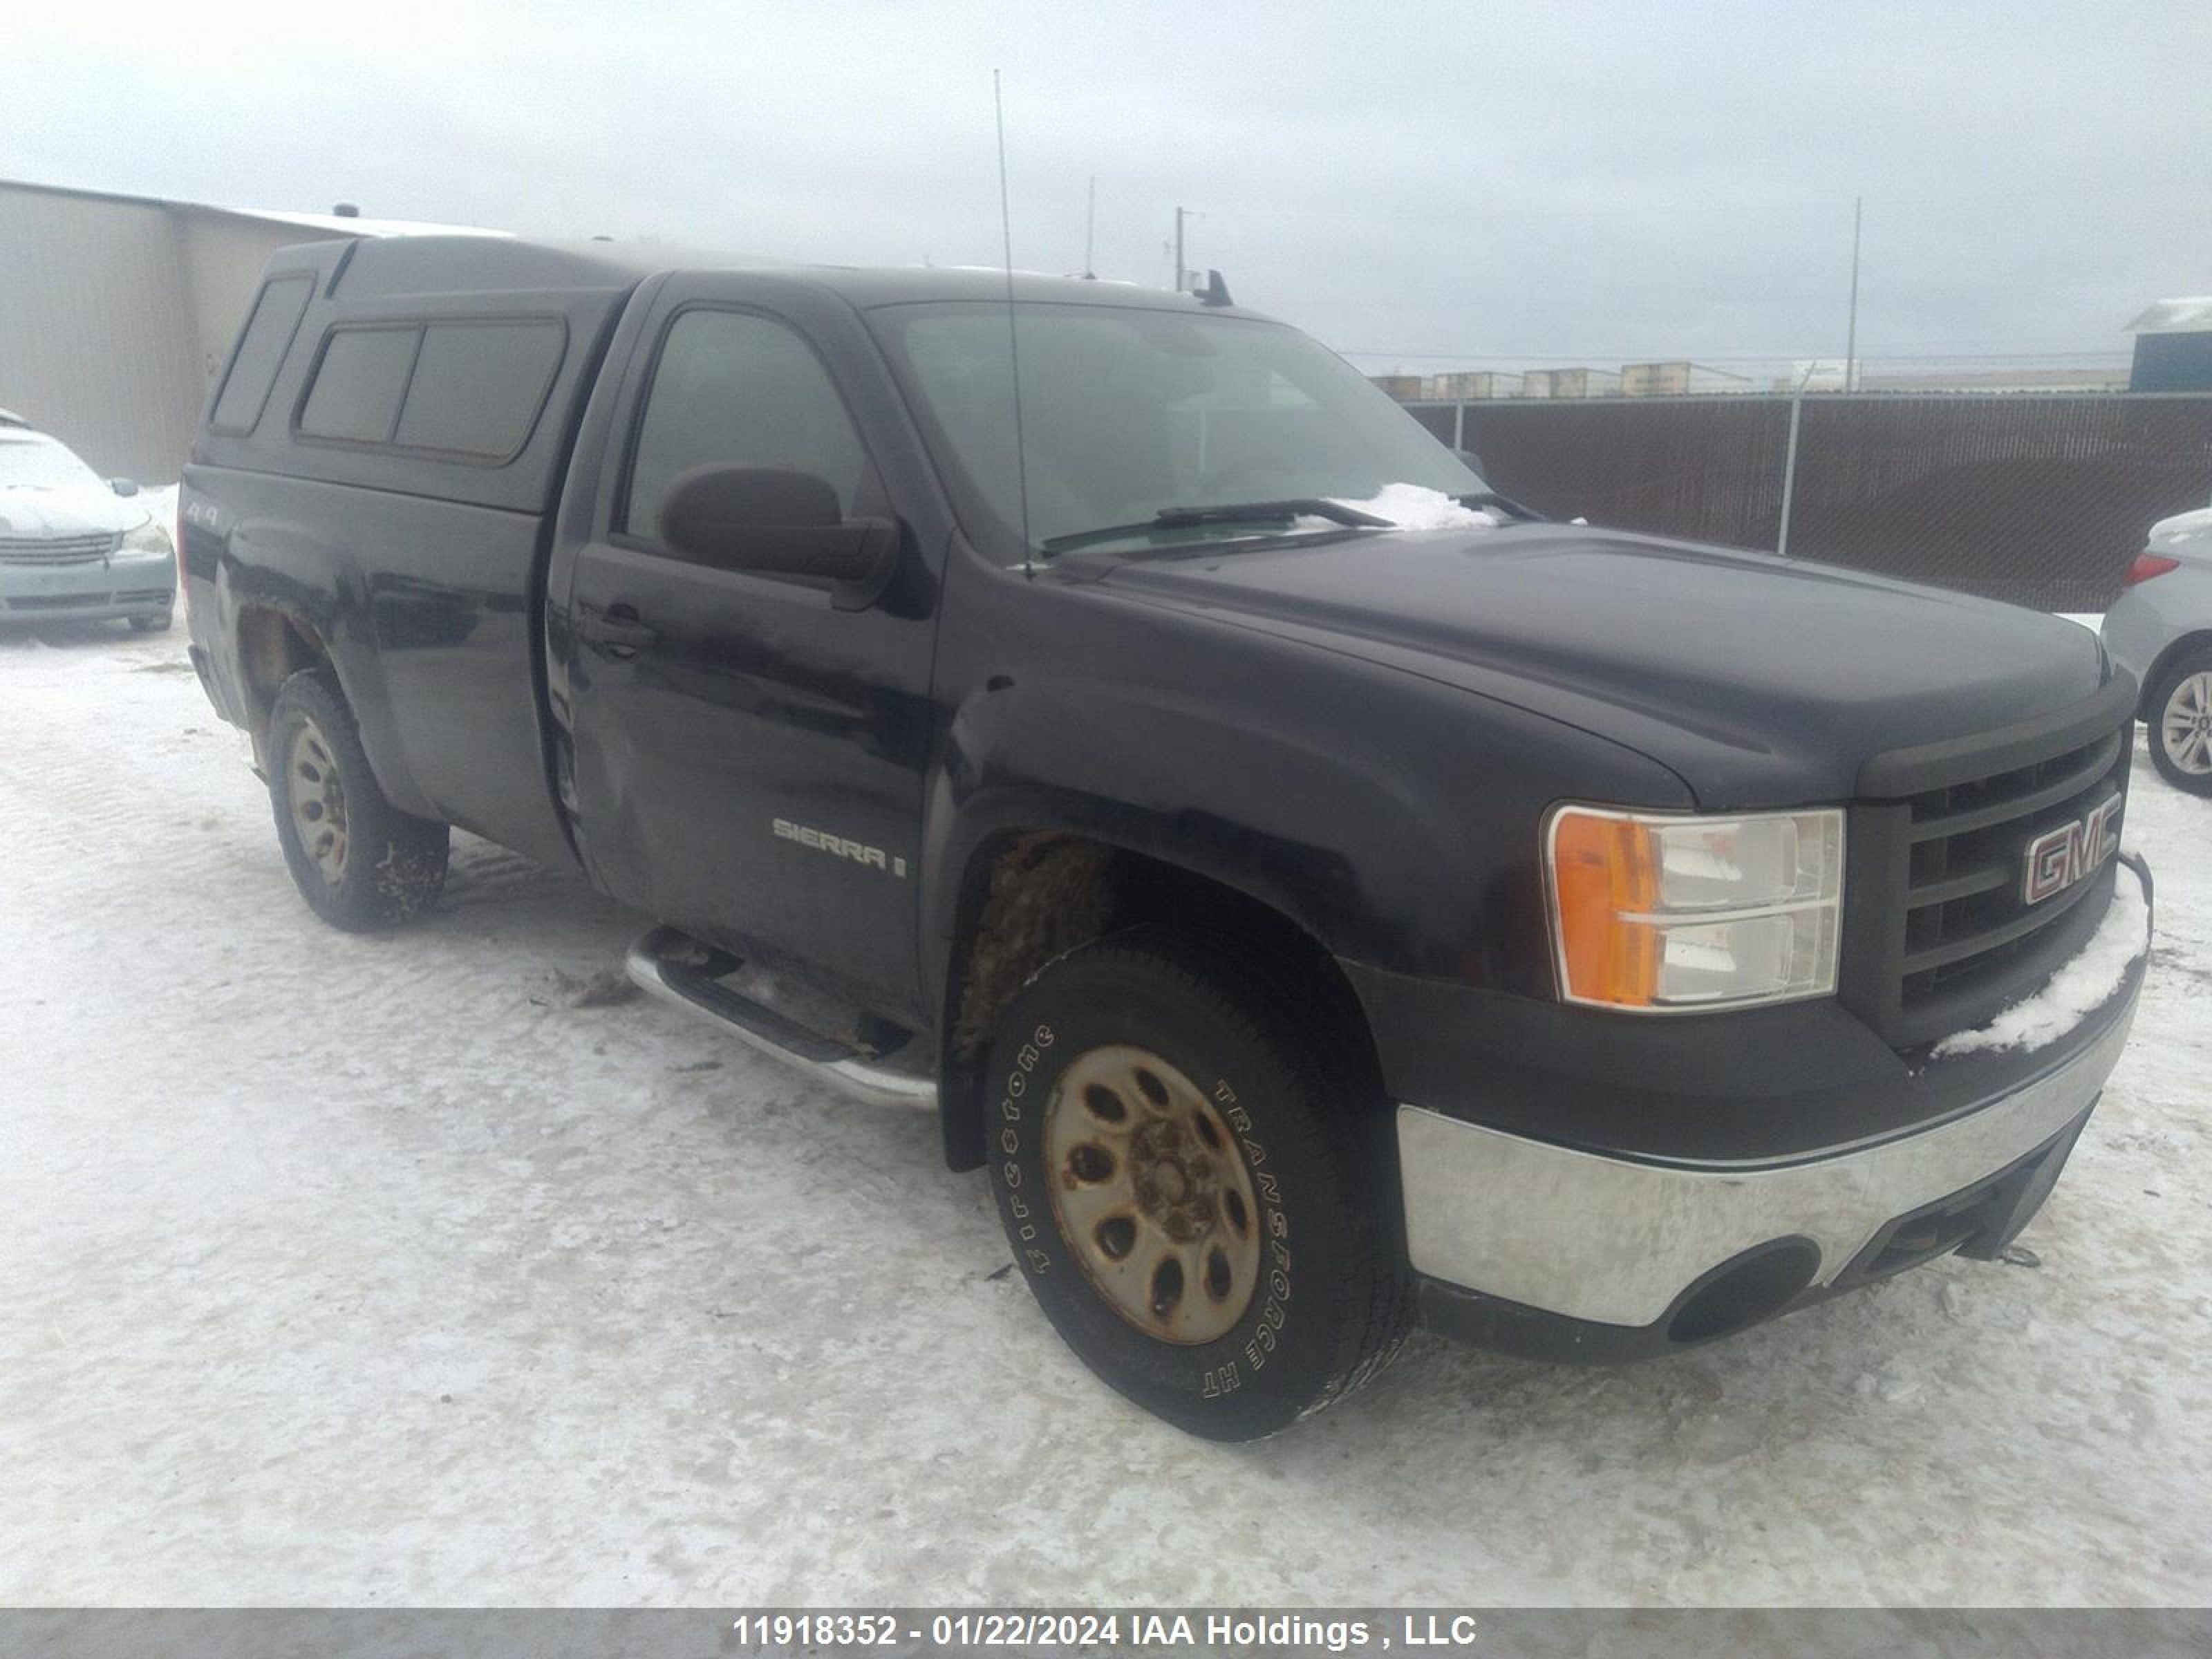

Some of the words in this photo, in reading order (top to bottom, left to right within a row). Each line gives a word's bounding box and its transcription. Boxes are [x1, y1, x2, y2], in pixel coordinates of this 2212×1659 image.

[772, 818, 886, 871] SIERRA
[2024, 791, 2122, 906] GMC
[1001, 1024, 1055, 1274] Firestone
[1214, 1078, 1292, 1371] TRANSFORCE
[1201, 1360, 1241, 1399] HT
